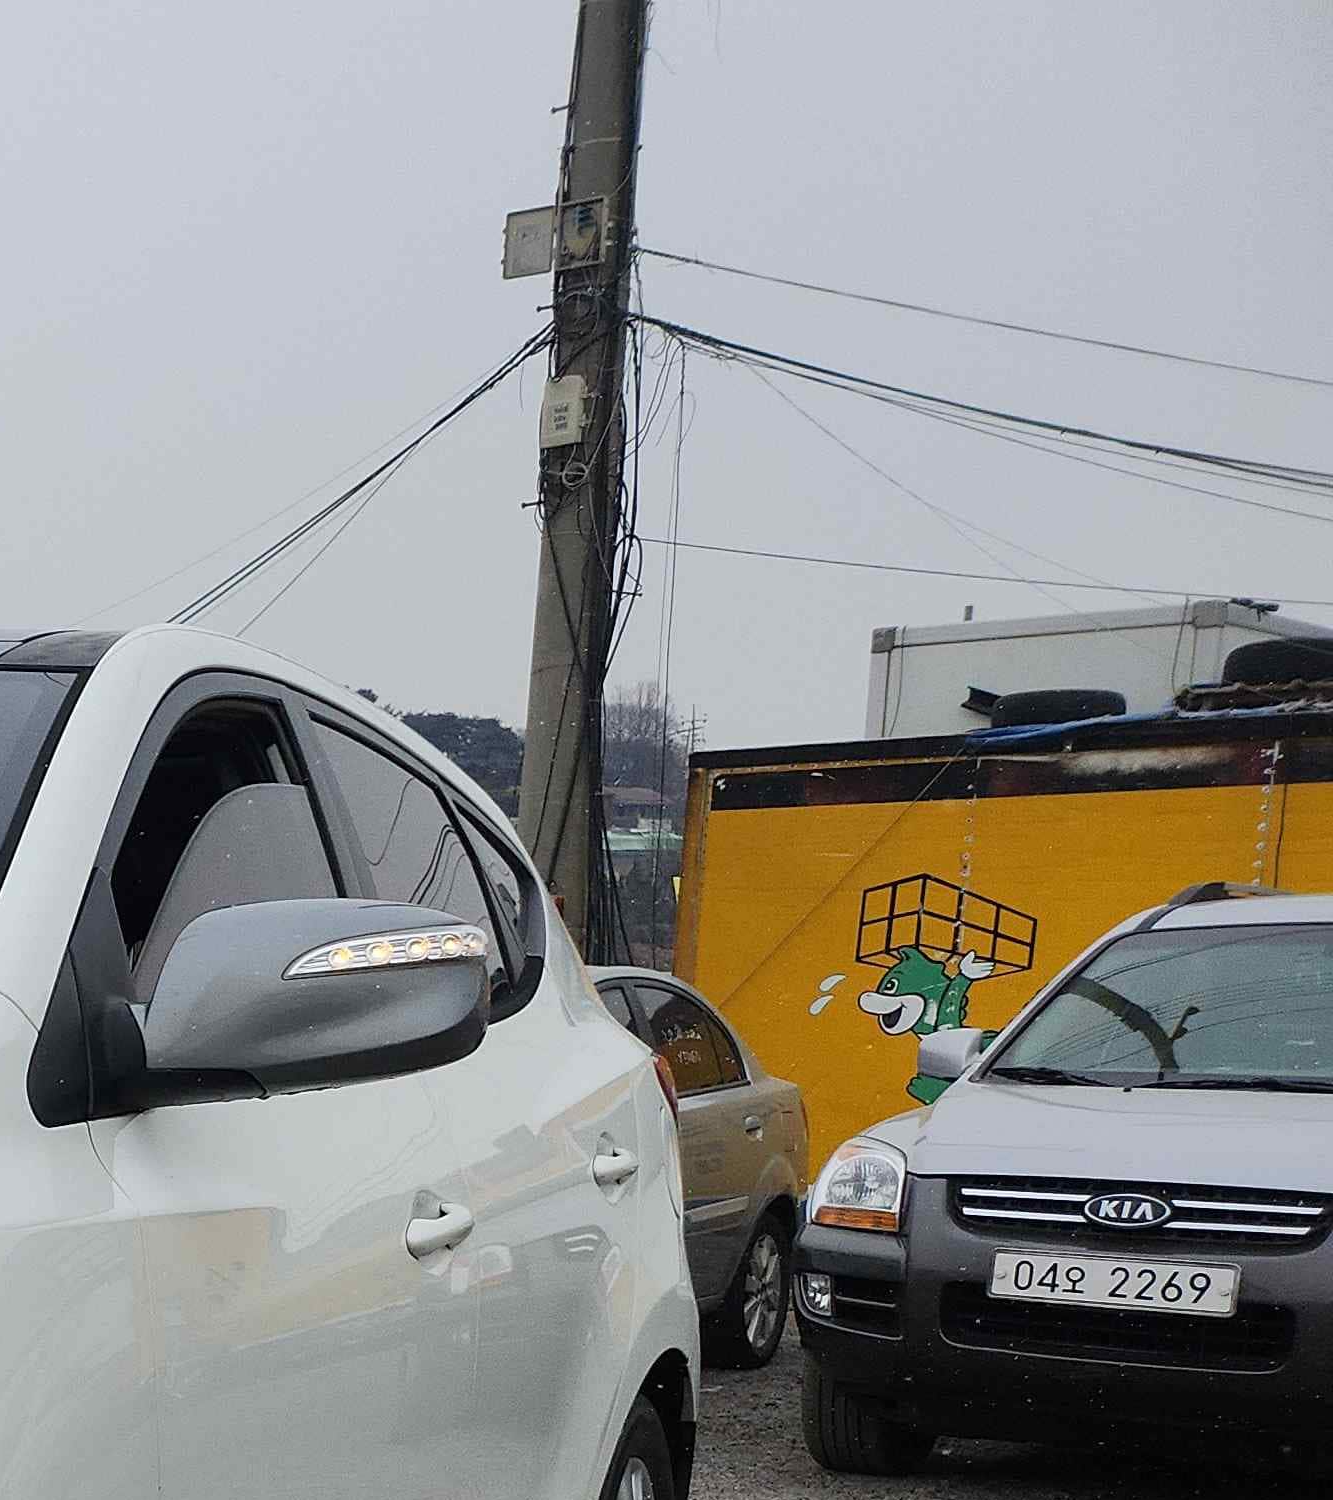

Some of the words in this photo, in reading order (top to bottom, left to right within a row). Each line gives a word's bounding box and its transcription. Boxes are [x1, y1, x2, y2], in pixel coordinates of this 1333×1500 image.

[1098, 1199, 1154, 1221] KIA
[1013, 1260, 1086, 1294] 04오
[1108, 1266, 1212, 1305] 2269
